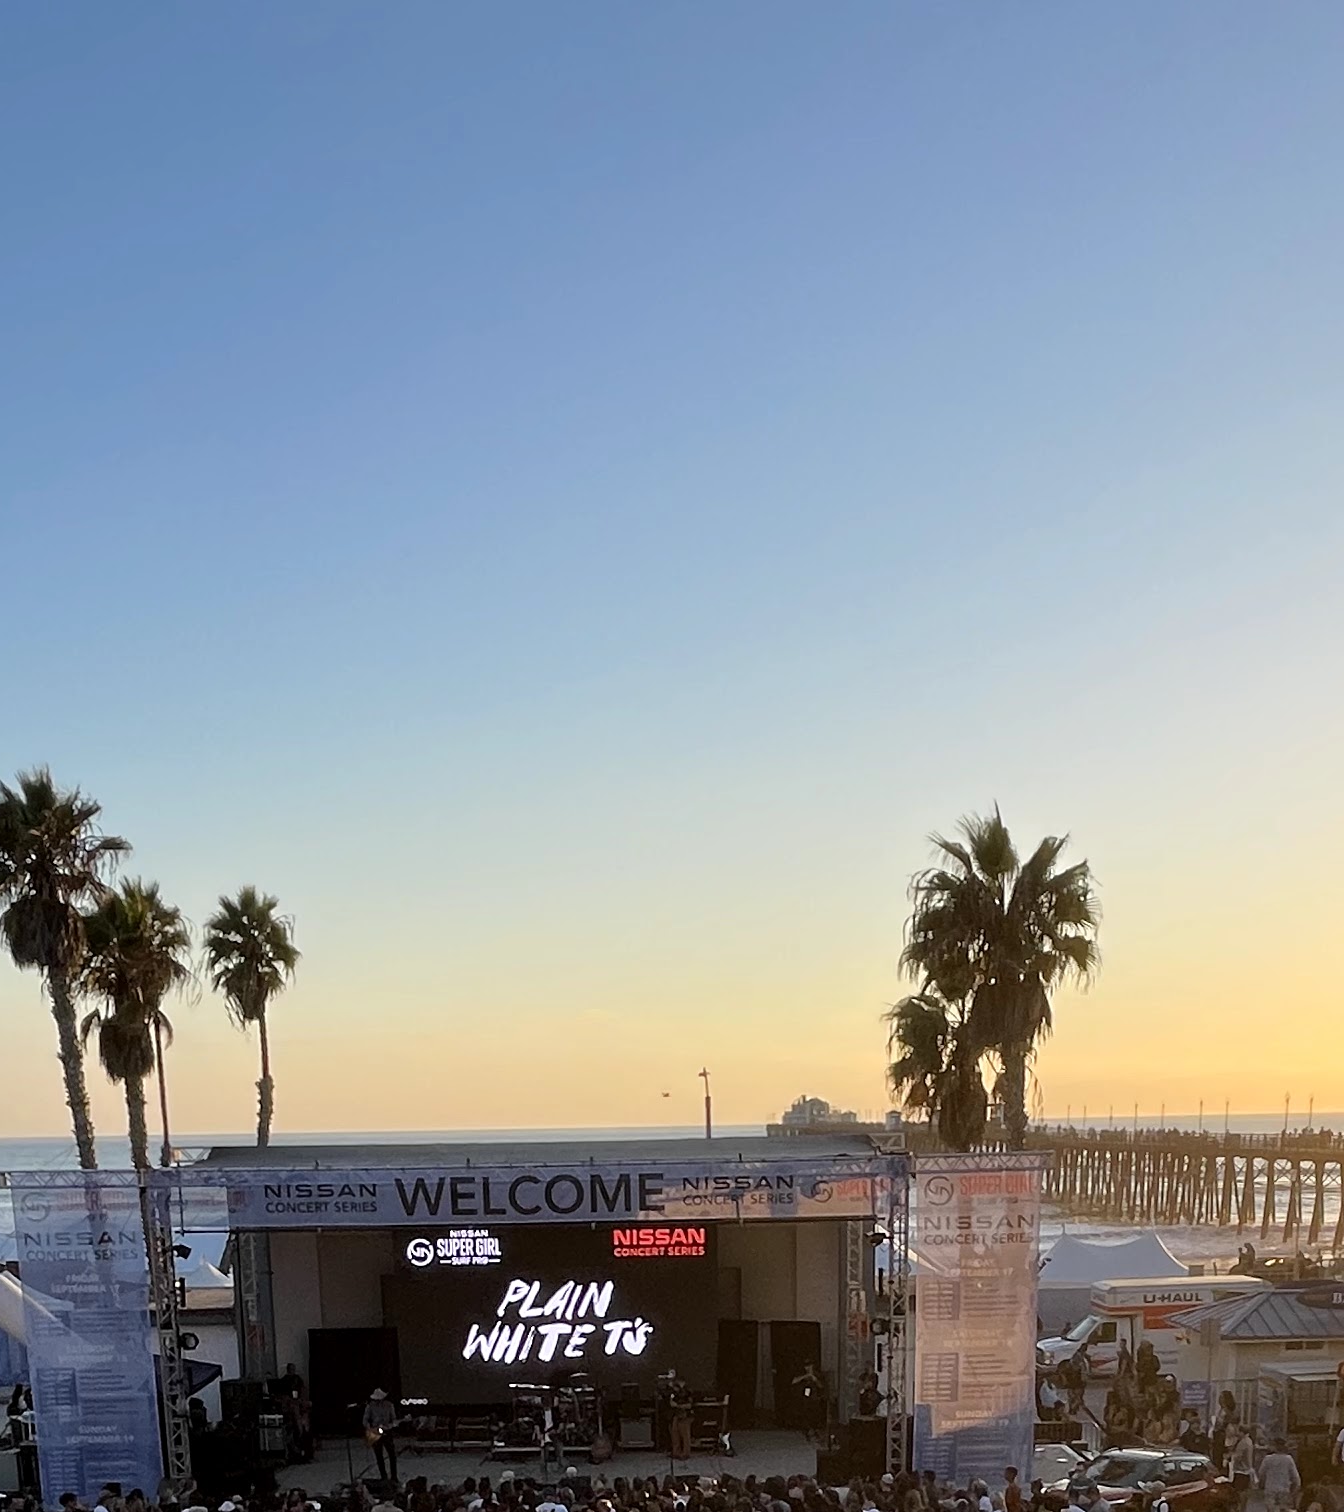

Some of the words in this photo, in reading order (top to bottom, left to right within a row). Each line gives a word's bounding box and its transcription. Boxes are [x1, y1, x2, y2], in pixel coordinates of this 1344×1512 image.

[683, 1175, 794, 1191] NISSAN
[264, 1184, 377, 1198] NISSAN
[394, 1173, 666, 1216] WELCOME
[265, 1201, 328, 1213] CONCERT
[334, 1200, 377, 1212] SERIES
[683, 1194, 744, 1206] CONCERT
[750, 1193, 794, 1205] SERIES
[924, 1214, 1034, 1230] NISSAN
[24, 1231, 136, 1247] NISSAN
[449, 1229, 489, 1238] NISSAN
[613, 1228, 706, 1246] NISSAN
[924, 1234, 985, 1245] CONCERT
[992, 1232, 1034, 1244] SERIES
[437, 1238, 474, 1256] SUPER
[476, 1238, 502, 1256] GIRL
[614, 1247, 665, 1257] CONCERT
[668, 1246, 705, 1256] SERIES
[26, 1250, 88, 1262] CONCERT
[496, 1279, 615, 1321] PLAIN
[1143, 1292, 1204, 1304] U-HAUL
[462, 1321, 596, 1364] WHITE
